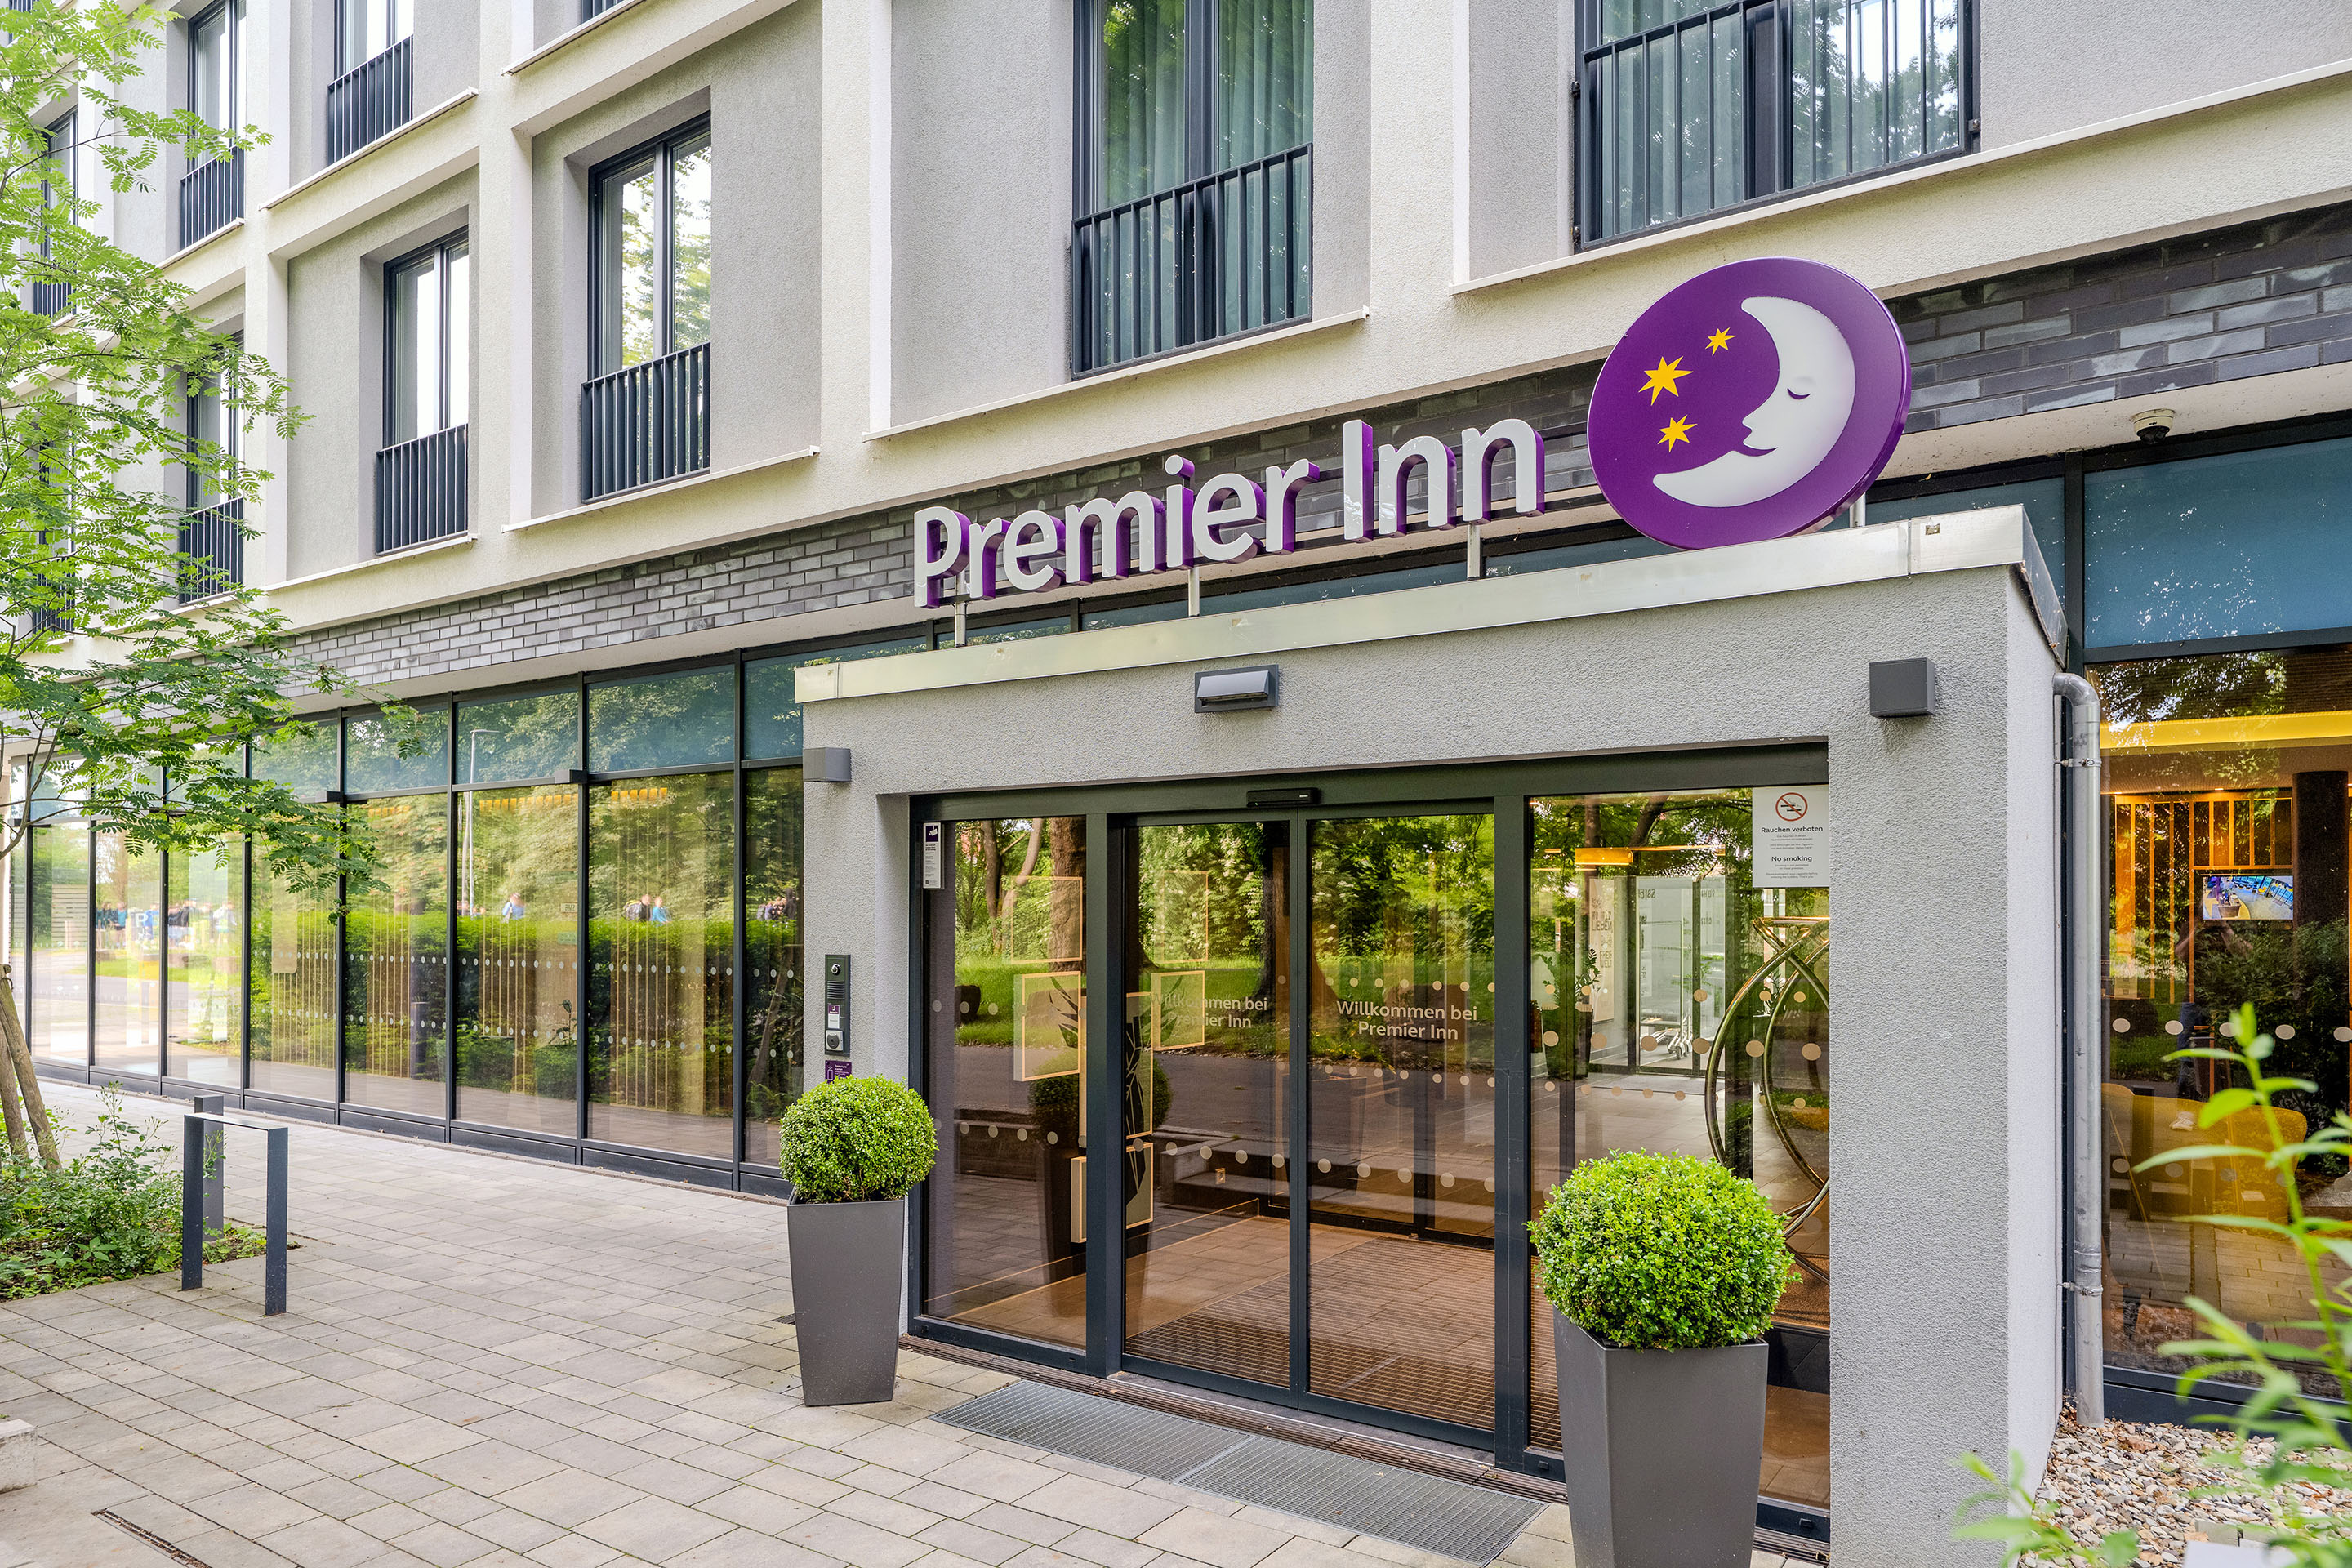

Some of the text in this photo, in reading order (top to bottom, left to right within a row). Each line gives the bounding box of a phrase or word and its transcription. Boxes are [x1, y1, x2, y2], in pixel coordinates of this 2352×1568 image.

[913, 418, 1546, 608] Premier Inn
[1245, 996, 1267, 1011] bei
[1336, 1000, 1477, 1021] Willkommen bei
[1228, 1014, 1252, 1028] Inn
[1358, 1021, 1459, 1040] Premier Inn
